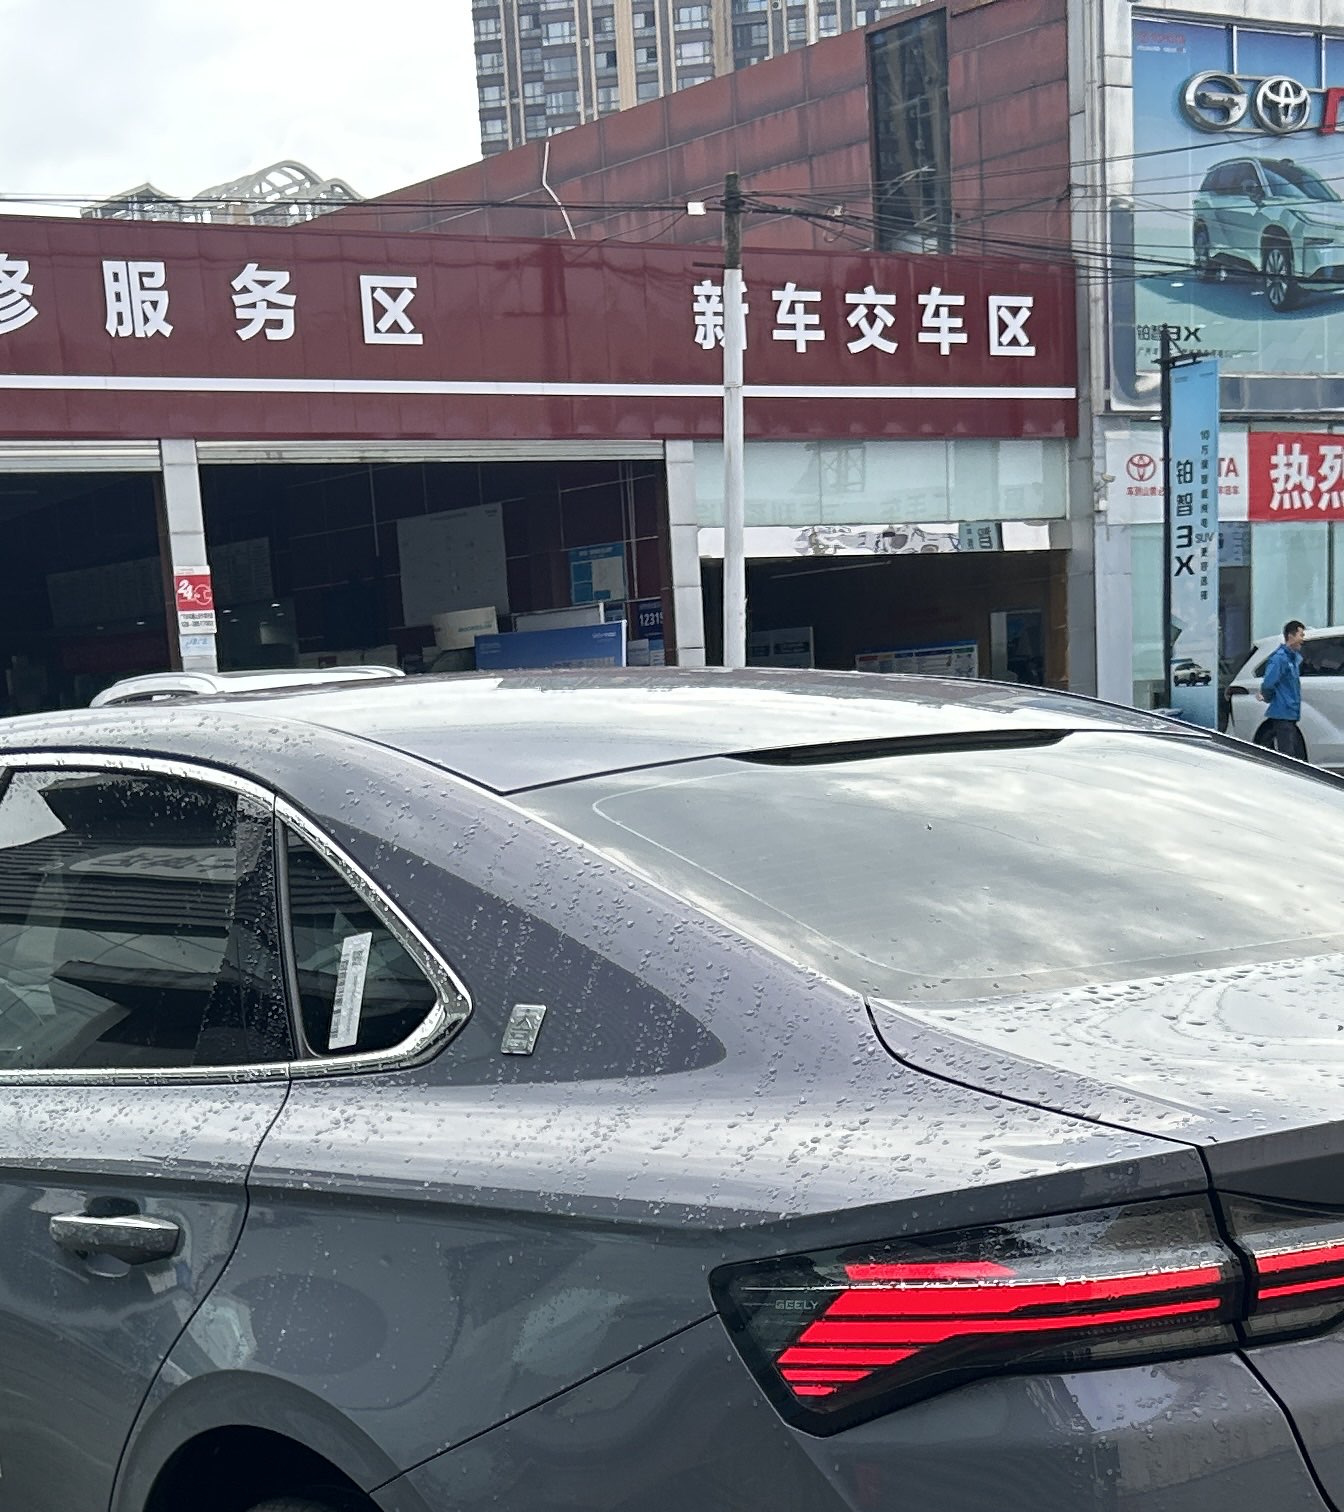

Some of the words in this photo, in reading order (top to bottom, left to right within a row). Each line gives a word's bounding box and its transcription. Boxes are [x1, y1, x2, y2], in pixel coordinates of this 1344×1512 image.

[693, 280, 1036, 357] 新车交车区
[1174, 460, 1195, 577] 铂智3X
